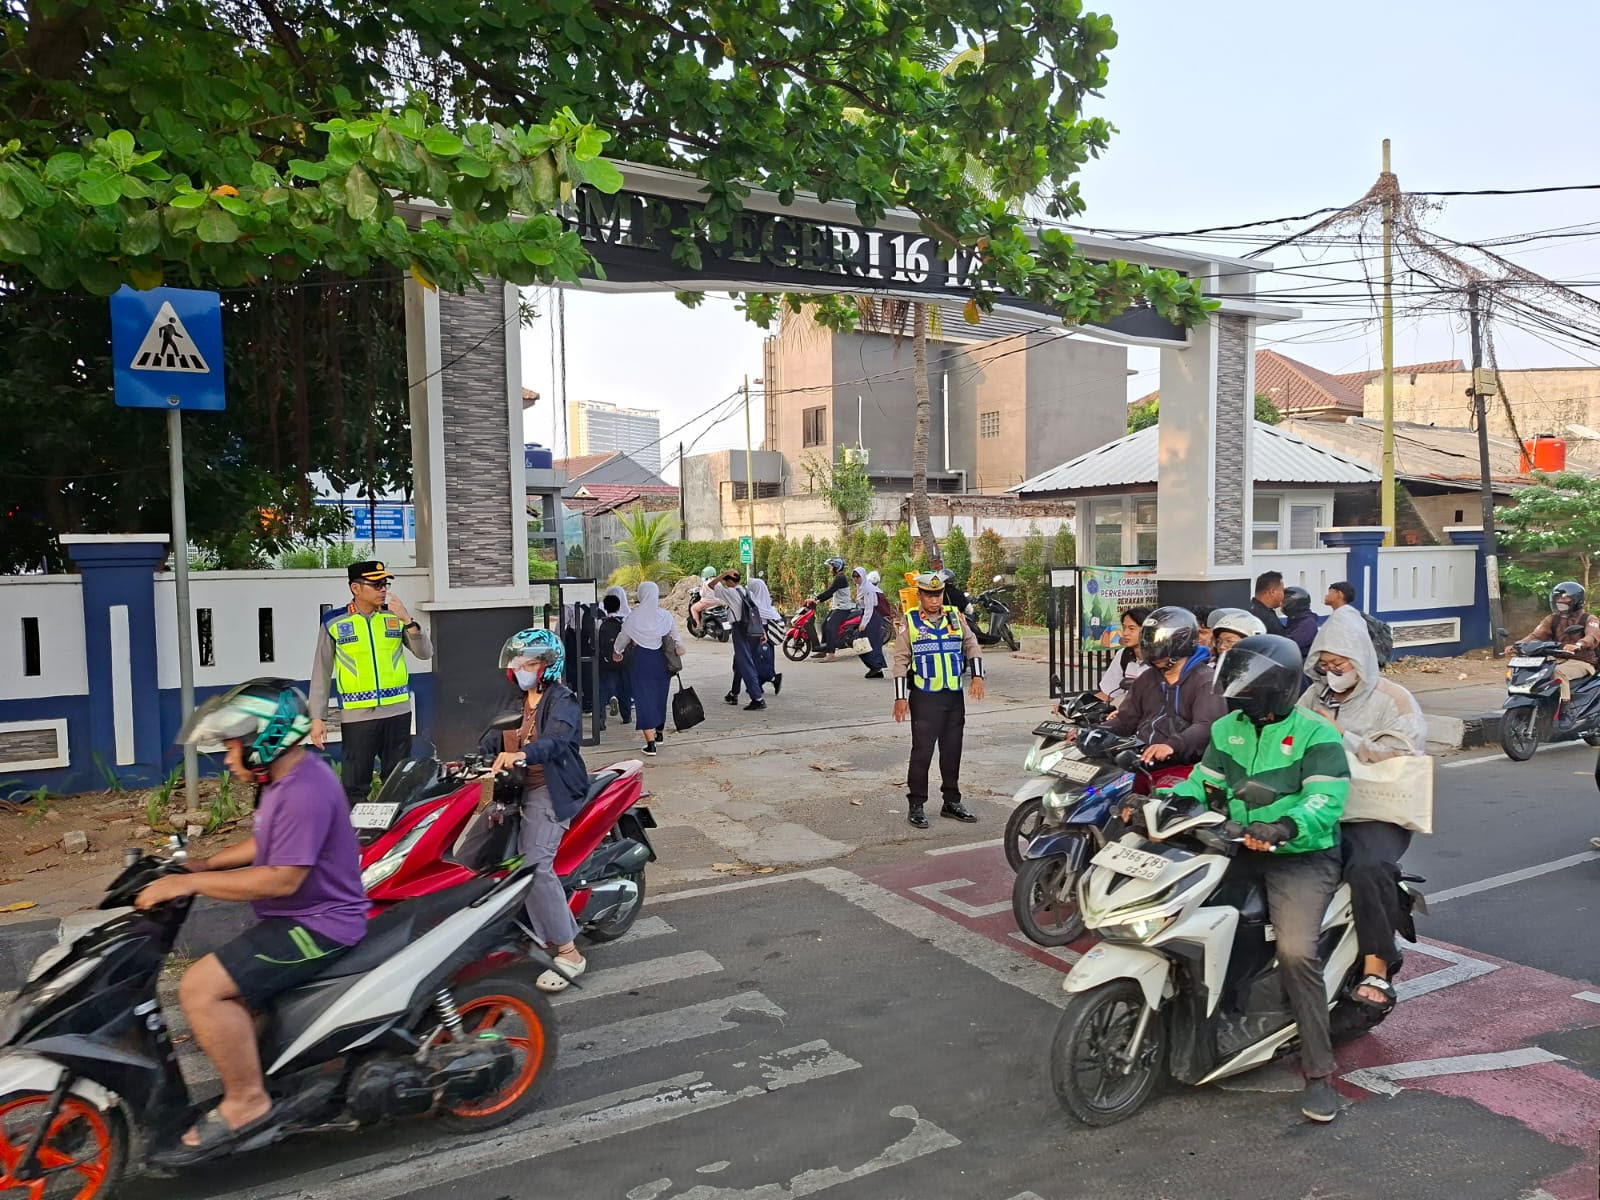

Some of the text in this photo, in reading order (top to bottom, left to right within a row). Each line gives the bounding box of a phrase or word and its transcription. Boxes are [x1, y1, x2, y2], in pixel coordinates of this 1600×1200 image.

[889, 234, 930, 284] 16
[1100, 588, 1143, 598] PERKEMAHAN
[1117, 597, 1143, 605] GERAKAN
